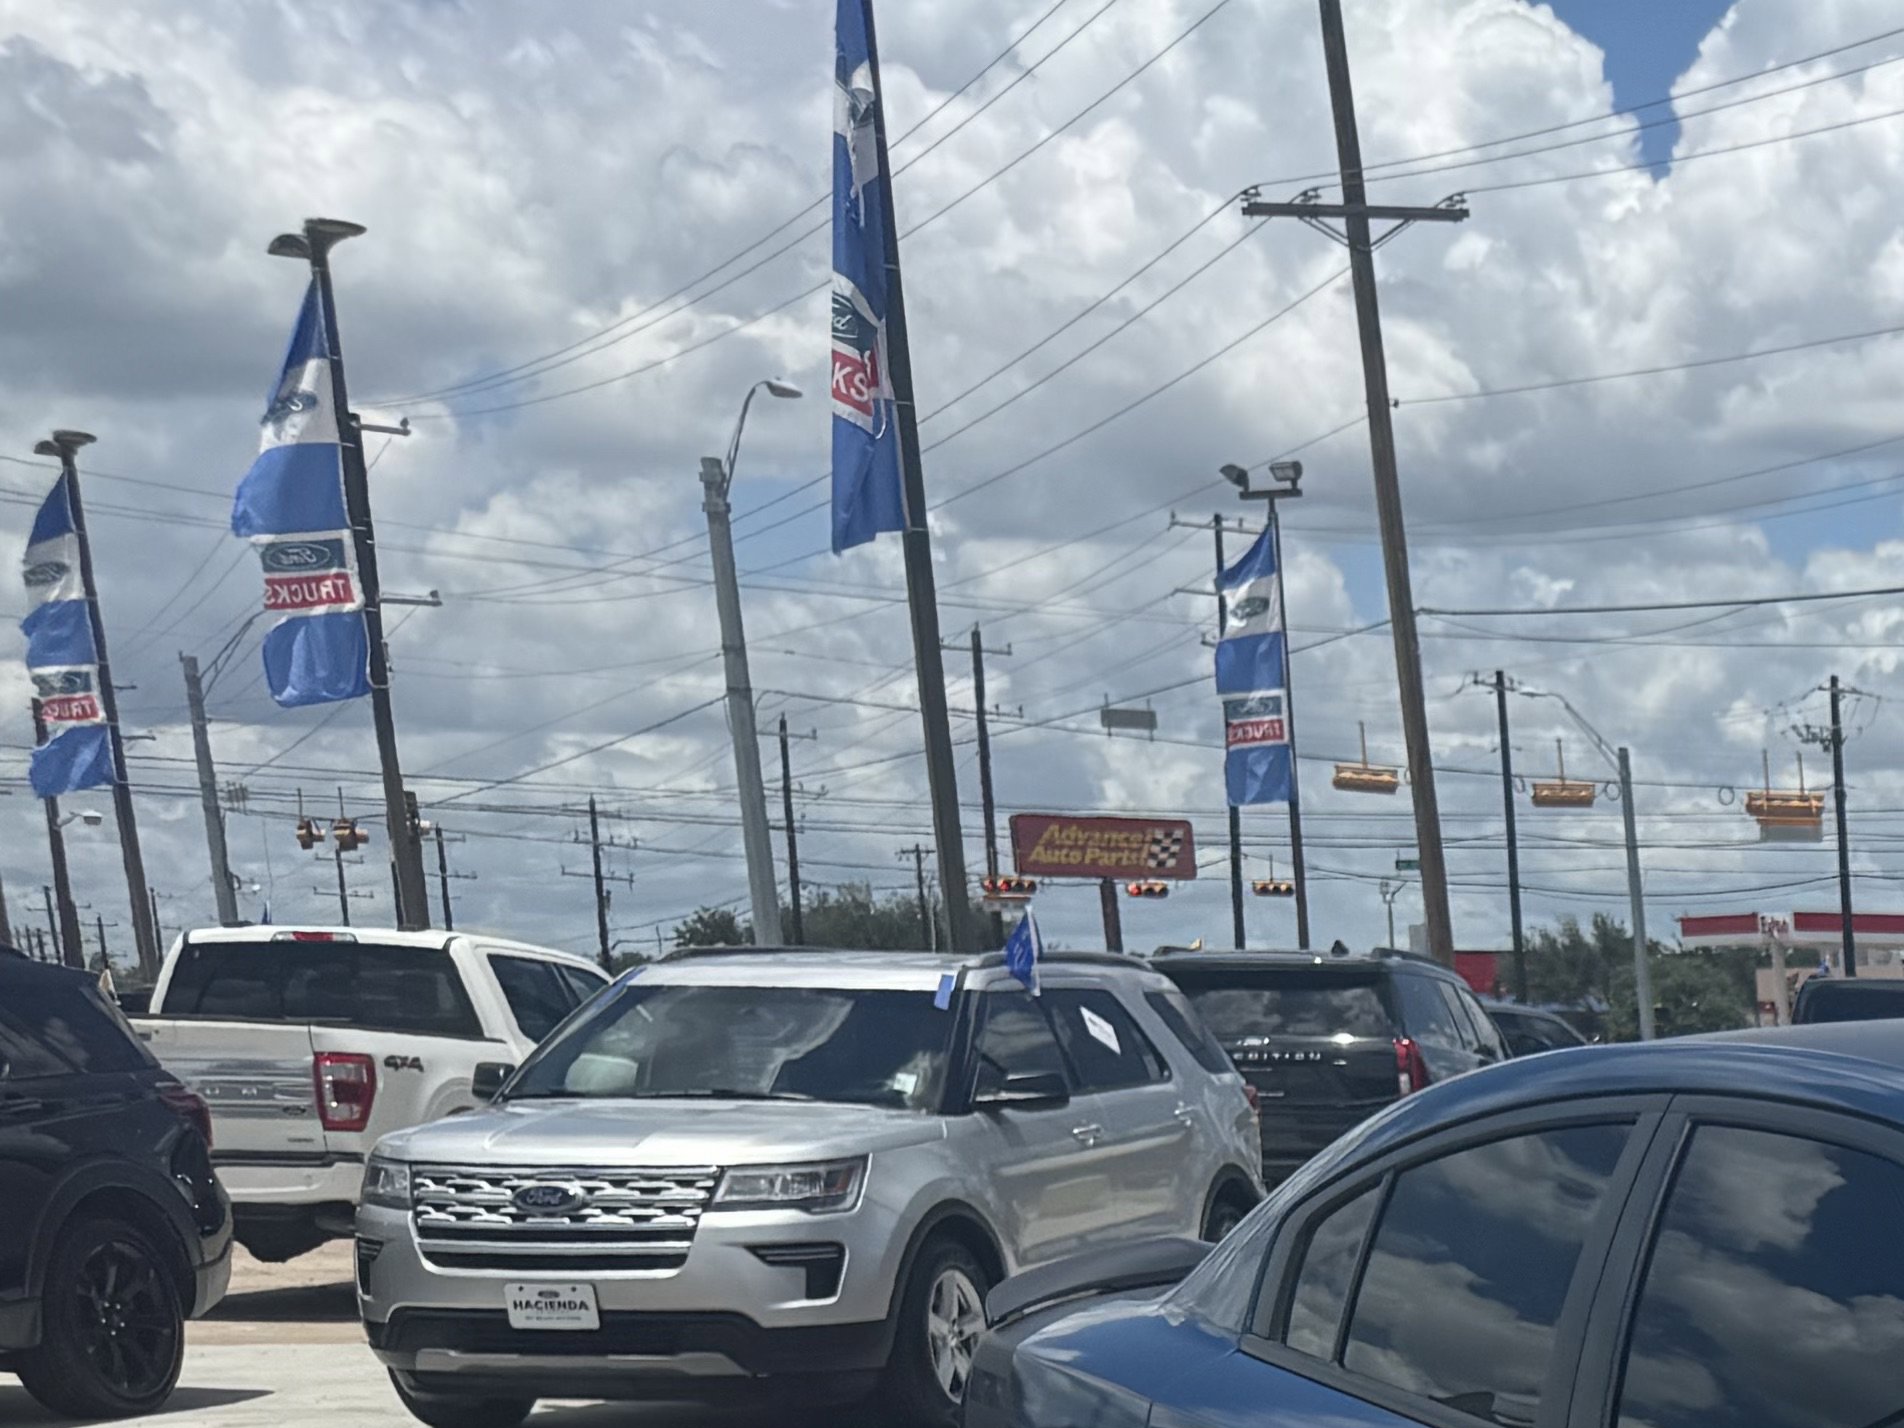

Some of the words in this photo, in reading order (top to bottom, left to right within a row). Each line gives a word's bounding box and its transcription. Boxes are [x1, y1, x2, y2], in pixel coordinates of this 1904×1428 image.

[1039, 824, 1145, 848] Advance
[1029, 845, 1082, 864] Auto
[512, 1299, 590, 1311] HACIENDA
